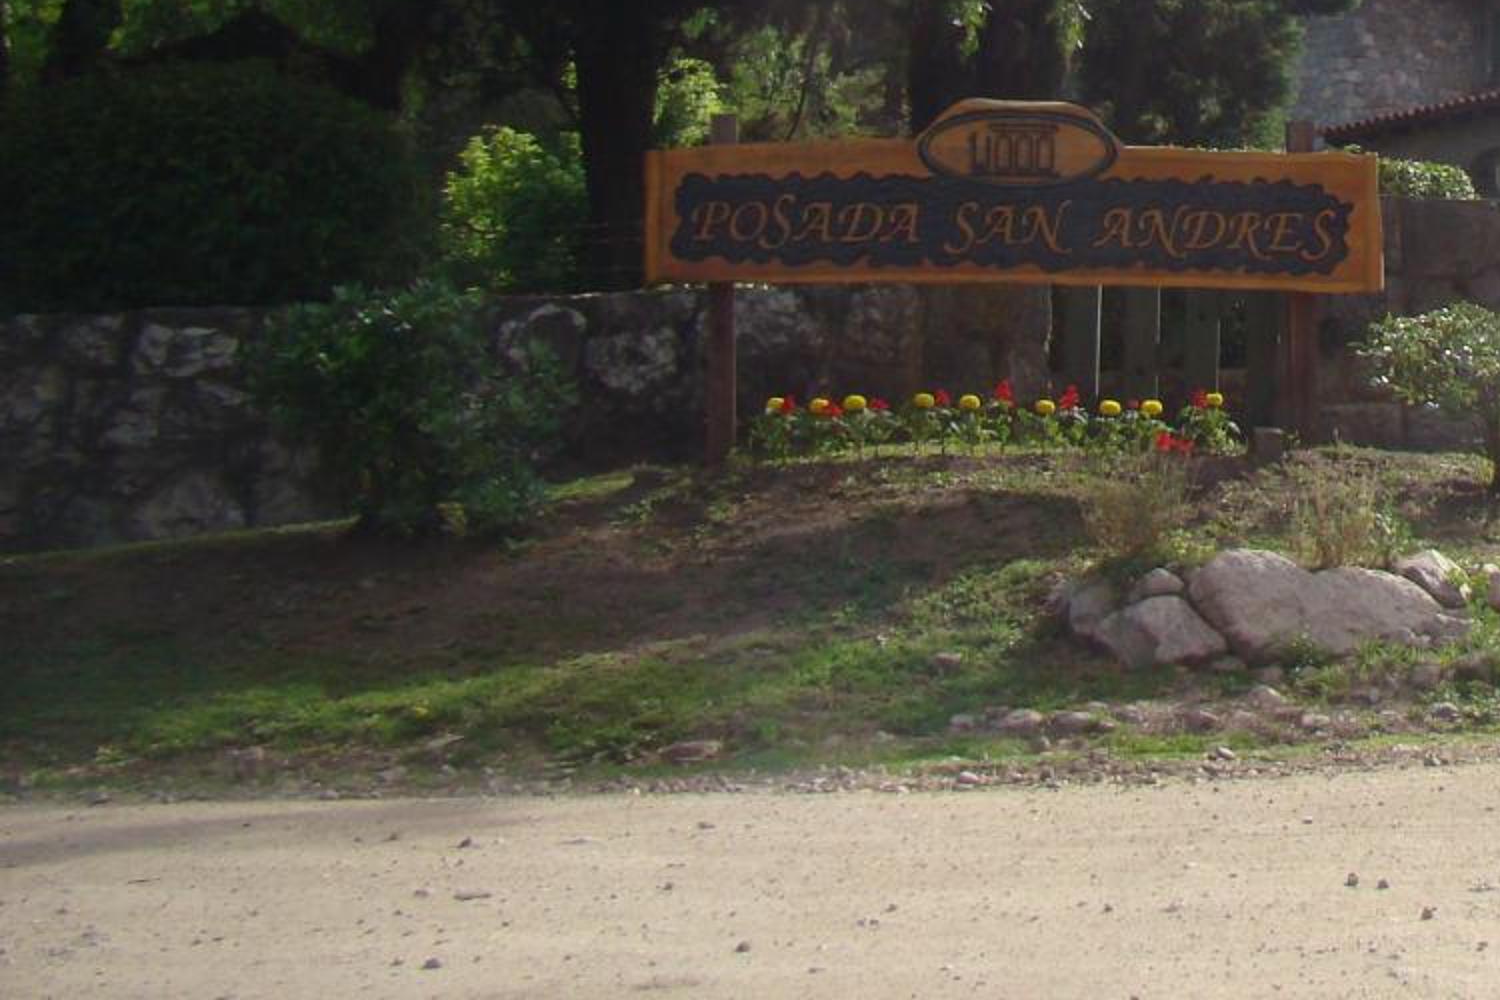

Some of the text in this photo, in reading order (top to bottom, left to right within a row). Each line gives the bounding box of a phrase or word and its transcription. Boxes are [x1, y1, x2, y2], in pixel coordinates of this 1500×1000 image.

[690, 194, 1336, 260] POSADA SAN ANDRES
